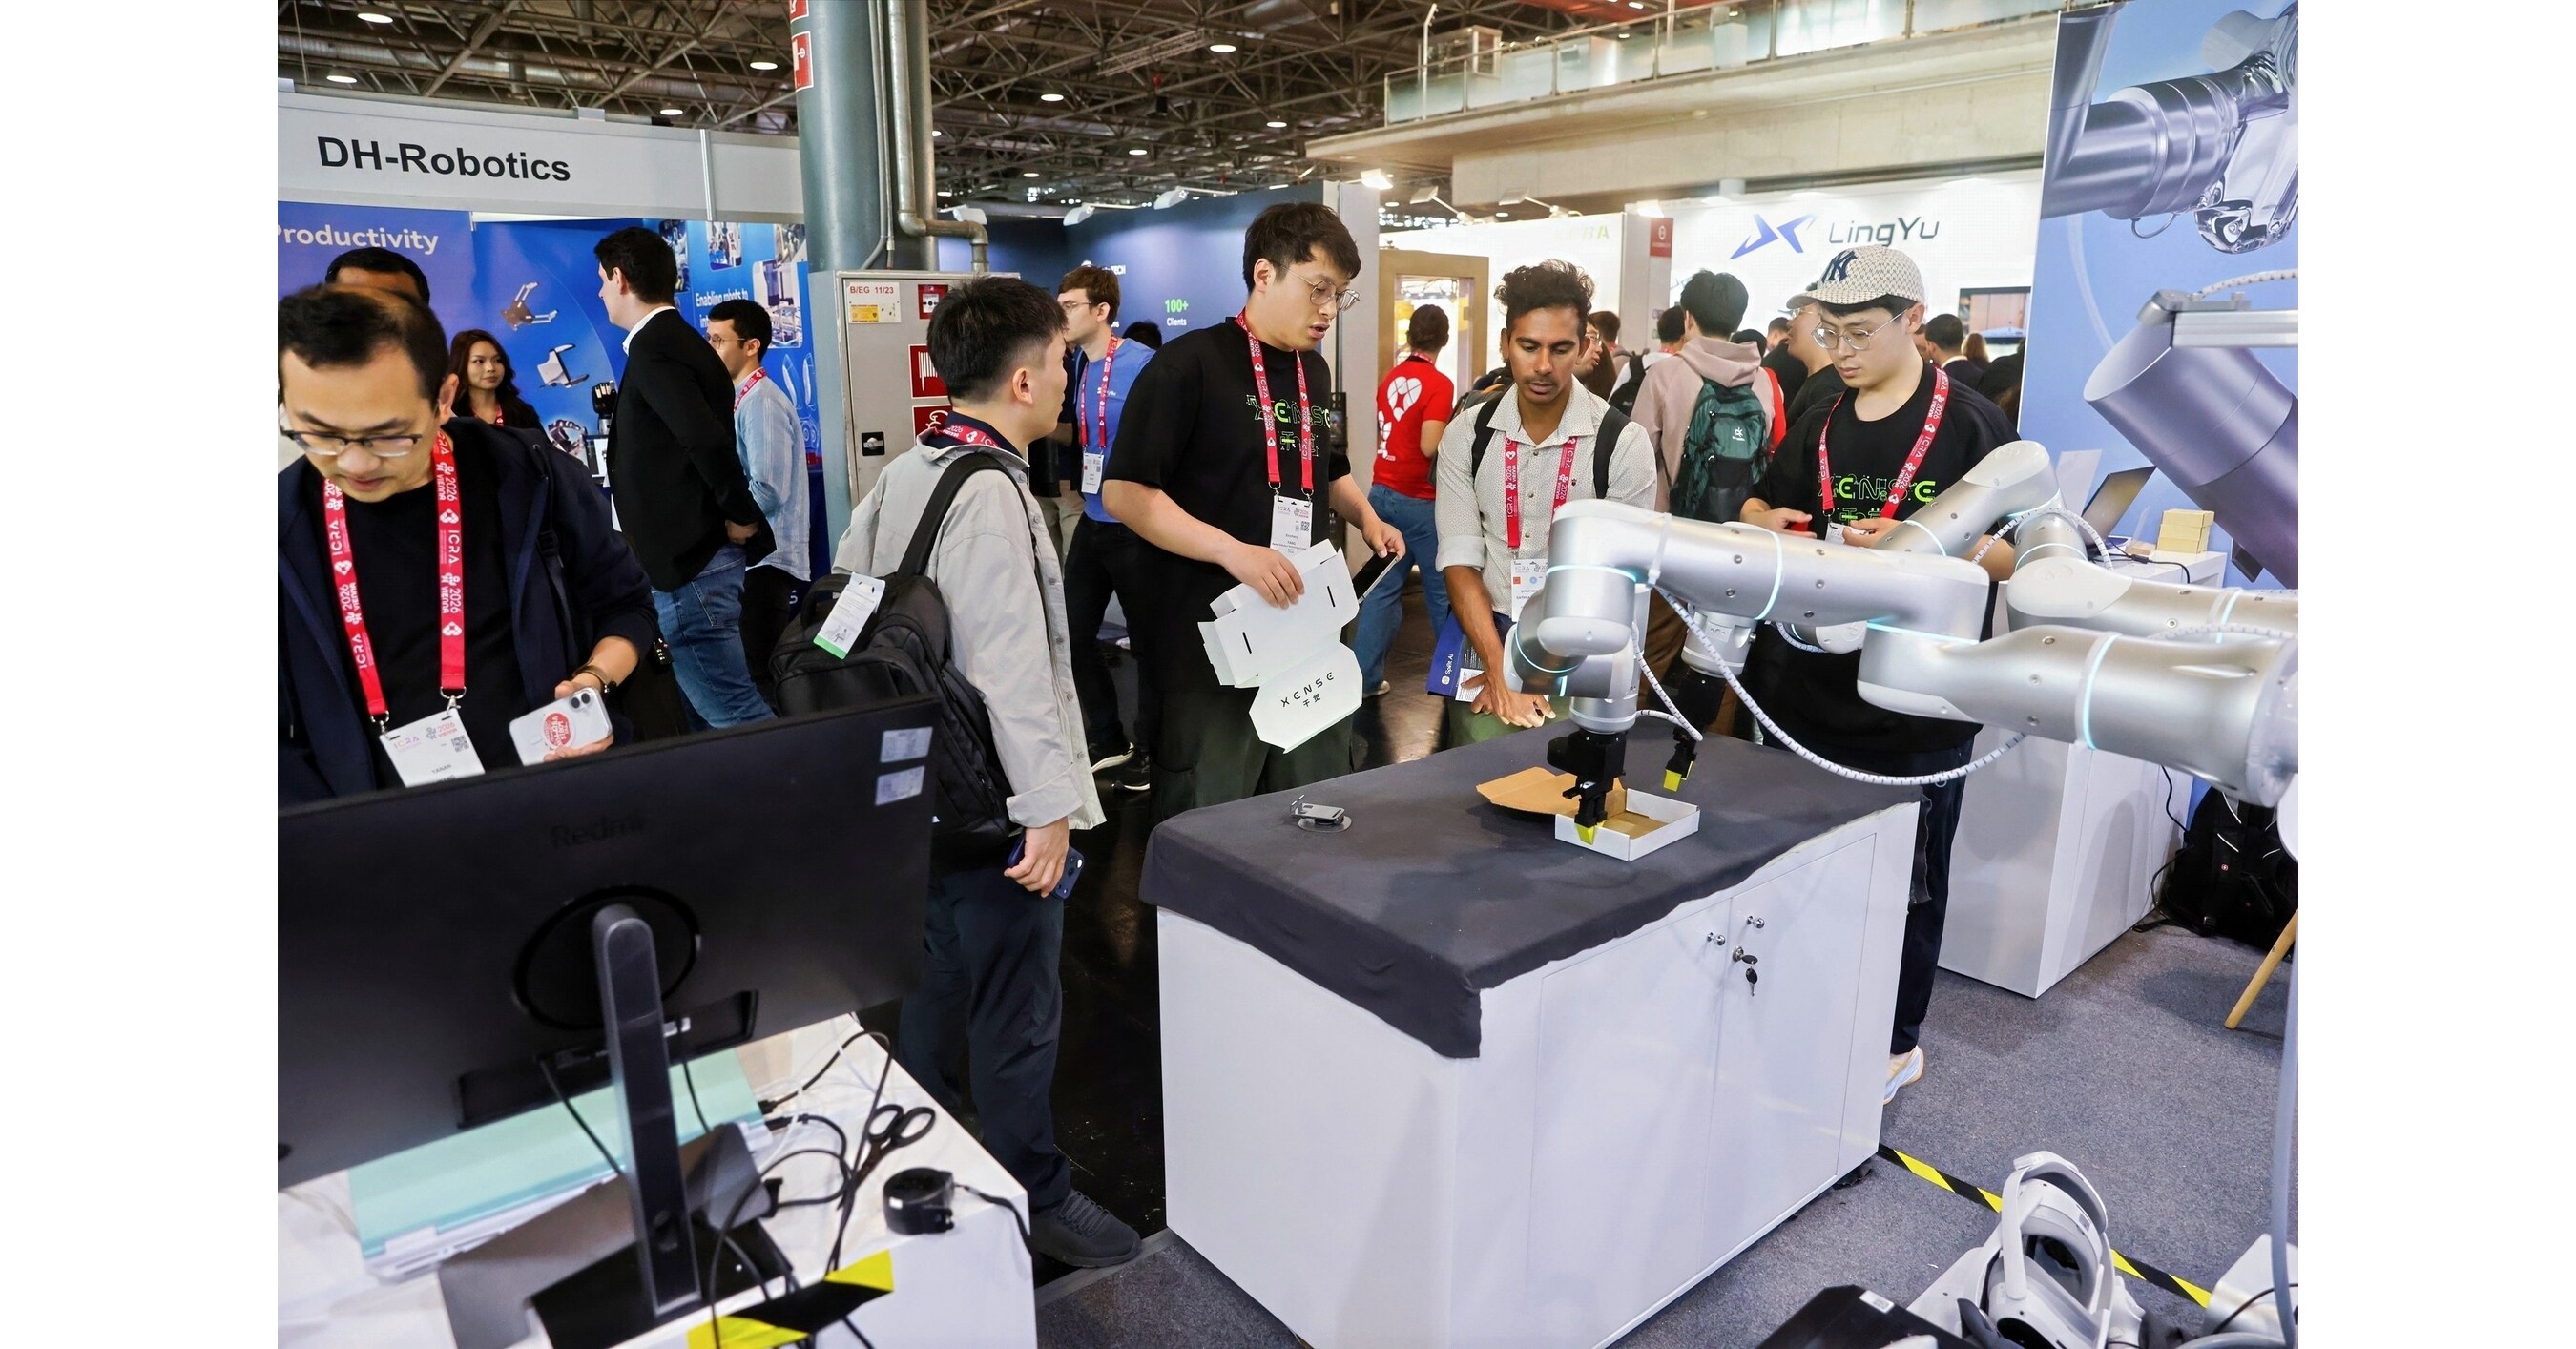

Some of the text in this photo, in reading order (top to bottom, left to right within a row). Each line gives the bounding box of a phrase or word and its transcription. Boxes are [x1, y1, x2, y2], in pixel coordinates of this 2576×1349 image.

[317, 135, 571, 182] DH-Robotics
[1828, 216, 1940, 248] LingYu
[1820, 249, 1858, 283] NY
[849, 286, 895, 295] B/EG 11/23
[1164, 299, 1189, 314] 100+
[1166, 317, 1187, 326] Clients
[438, 431, 450, 455] CRA
[981, 435, 999, 447] IC
[1915, 436, 1932, 459] ICRA
[1565, 447, 1575, 468] ICRA
[446, 476, 458, 502] 2026
[329, 519, 343, 556] ICRA
[448, 529, 460, 564] ICRA
[339, 584, 349, 611] 2026
[449, 588, 462, 614] 2026
[352, 633, 367, 669] ICRA
[1280, 671, 1335, 708] XENSE
[550, 810, 645, 848] Redmi
